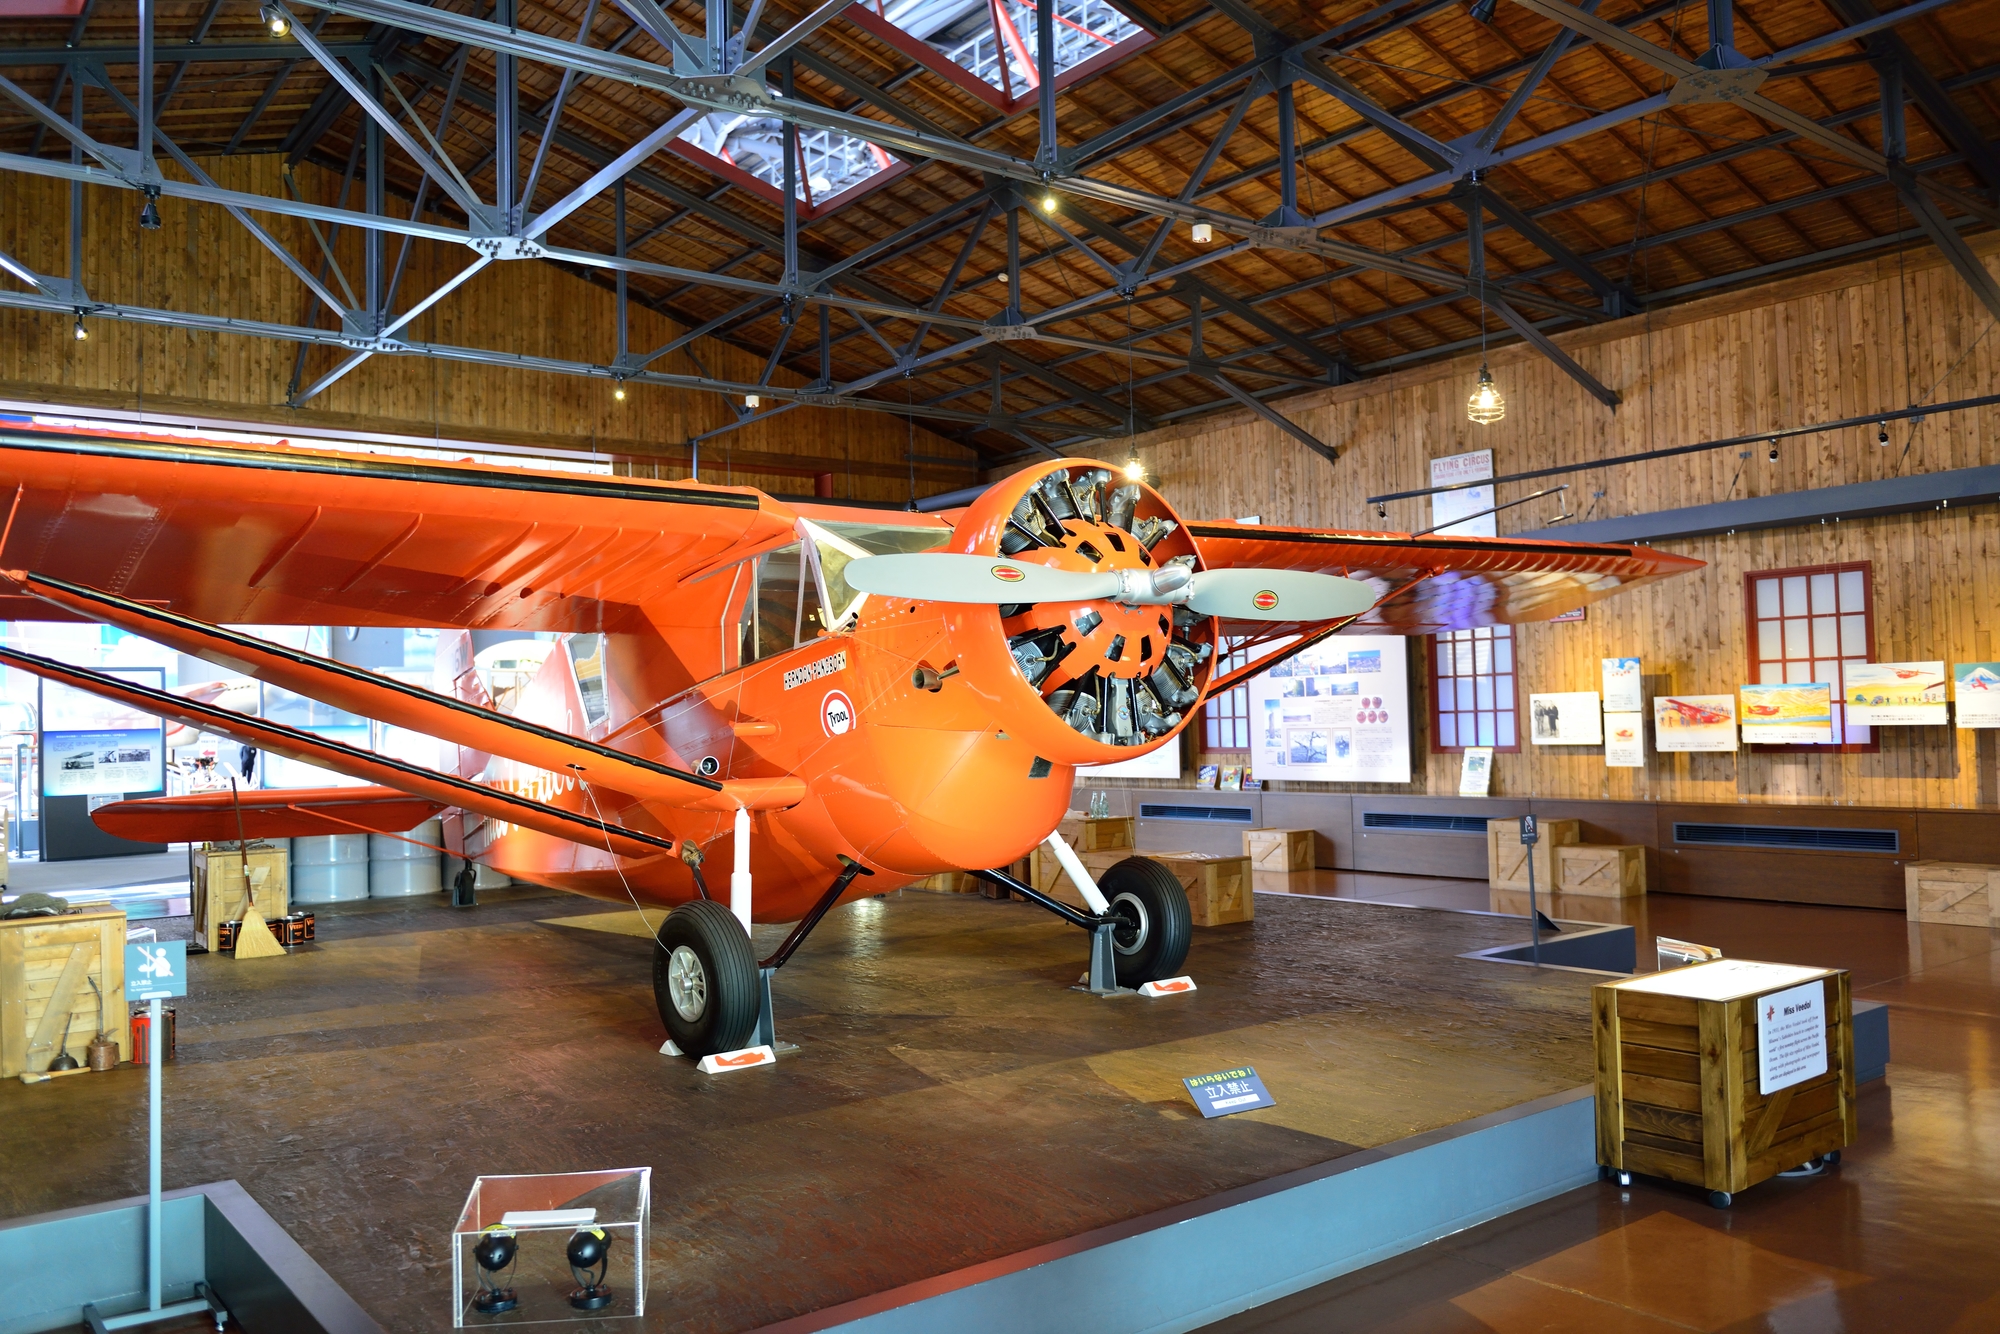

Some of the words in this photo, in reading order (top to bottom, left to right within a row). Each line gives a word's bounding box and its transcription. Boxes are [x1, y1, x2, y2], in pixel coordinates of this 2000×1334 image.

[1433, 460, 1459, 472] FLYING
[1463, 454, 1490, 467] CIRCUS
[784, 650, 846, 690] HERNDON-PANGBORN
[1784, 1006, 1794, 1016] Miss
[1795, 1000, 1812, 1012] Veedol
[1205, 1080, 1253, 1098] 立入禁止
